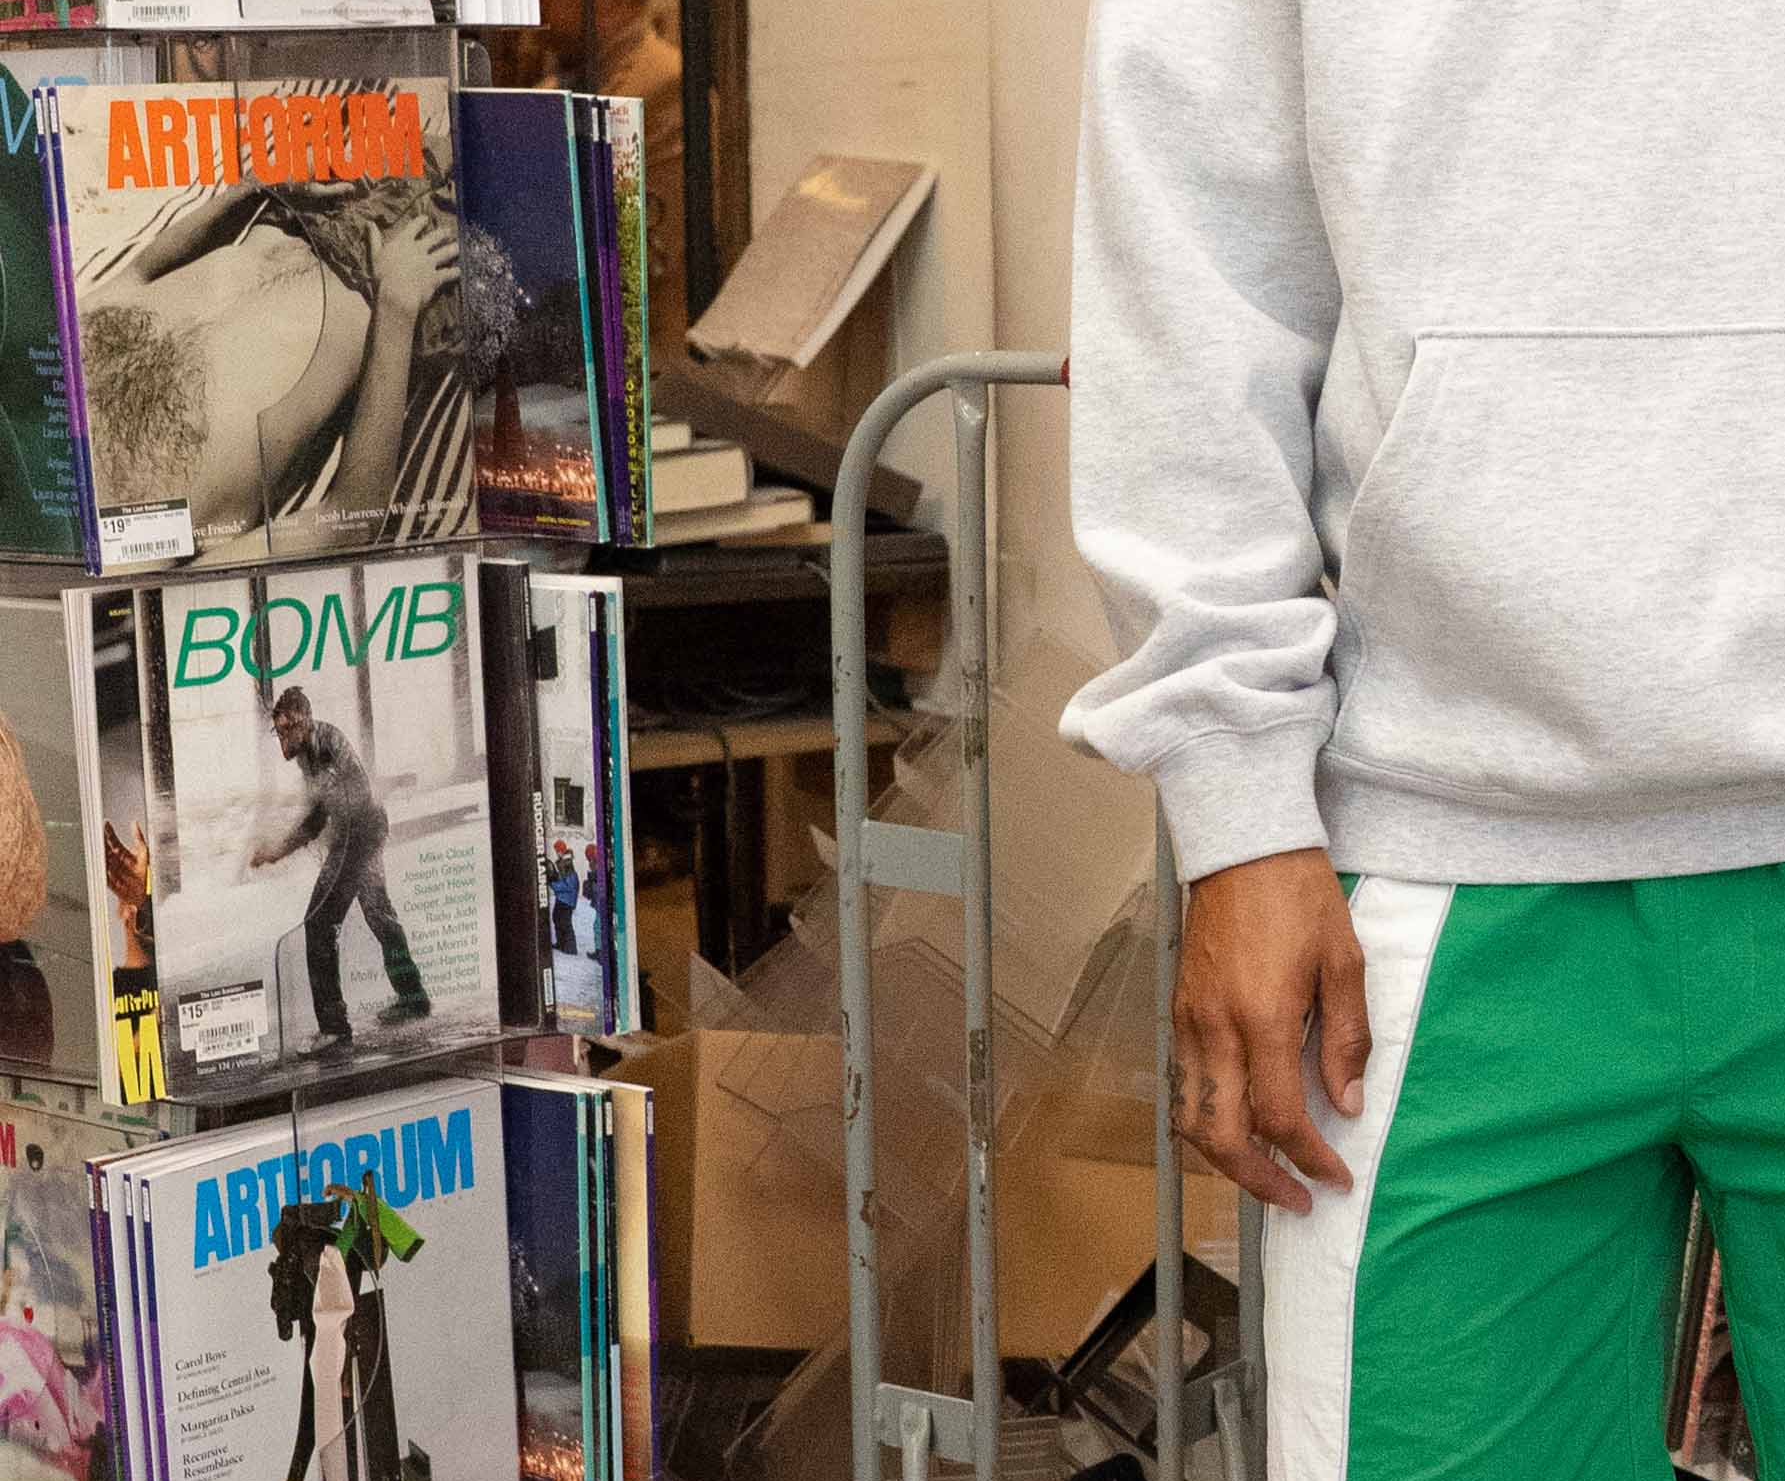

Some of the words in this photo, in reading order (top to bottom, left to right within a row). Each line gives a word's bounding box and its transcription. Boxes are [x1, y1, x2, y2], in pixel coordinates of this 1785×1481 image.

[107, 92, 424, 190] ARTFORUM
[173, 581, 464, 690] BOMB
[175, 1355, 204, 1373] Carol
[177, 1382, 219, 1405] Defining
[221, 1369, 252, 1390] Central
[181, 1412, 229, 1433] Margarita
[182, 1444, 228, 1466] Recursive
